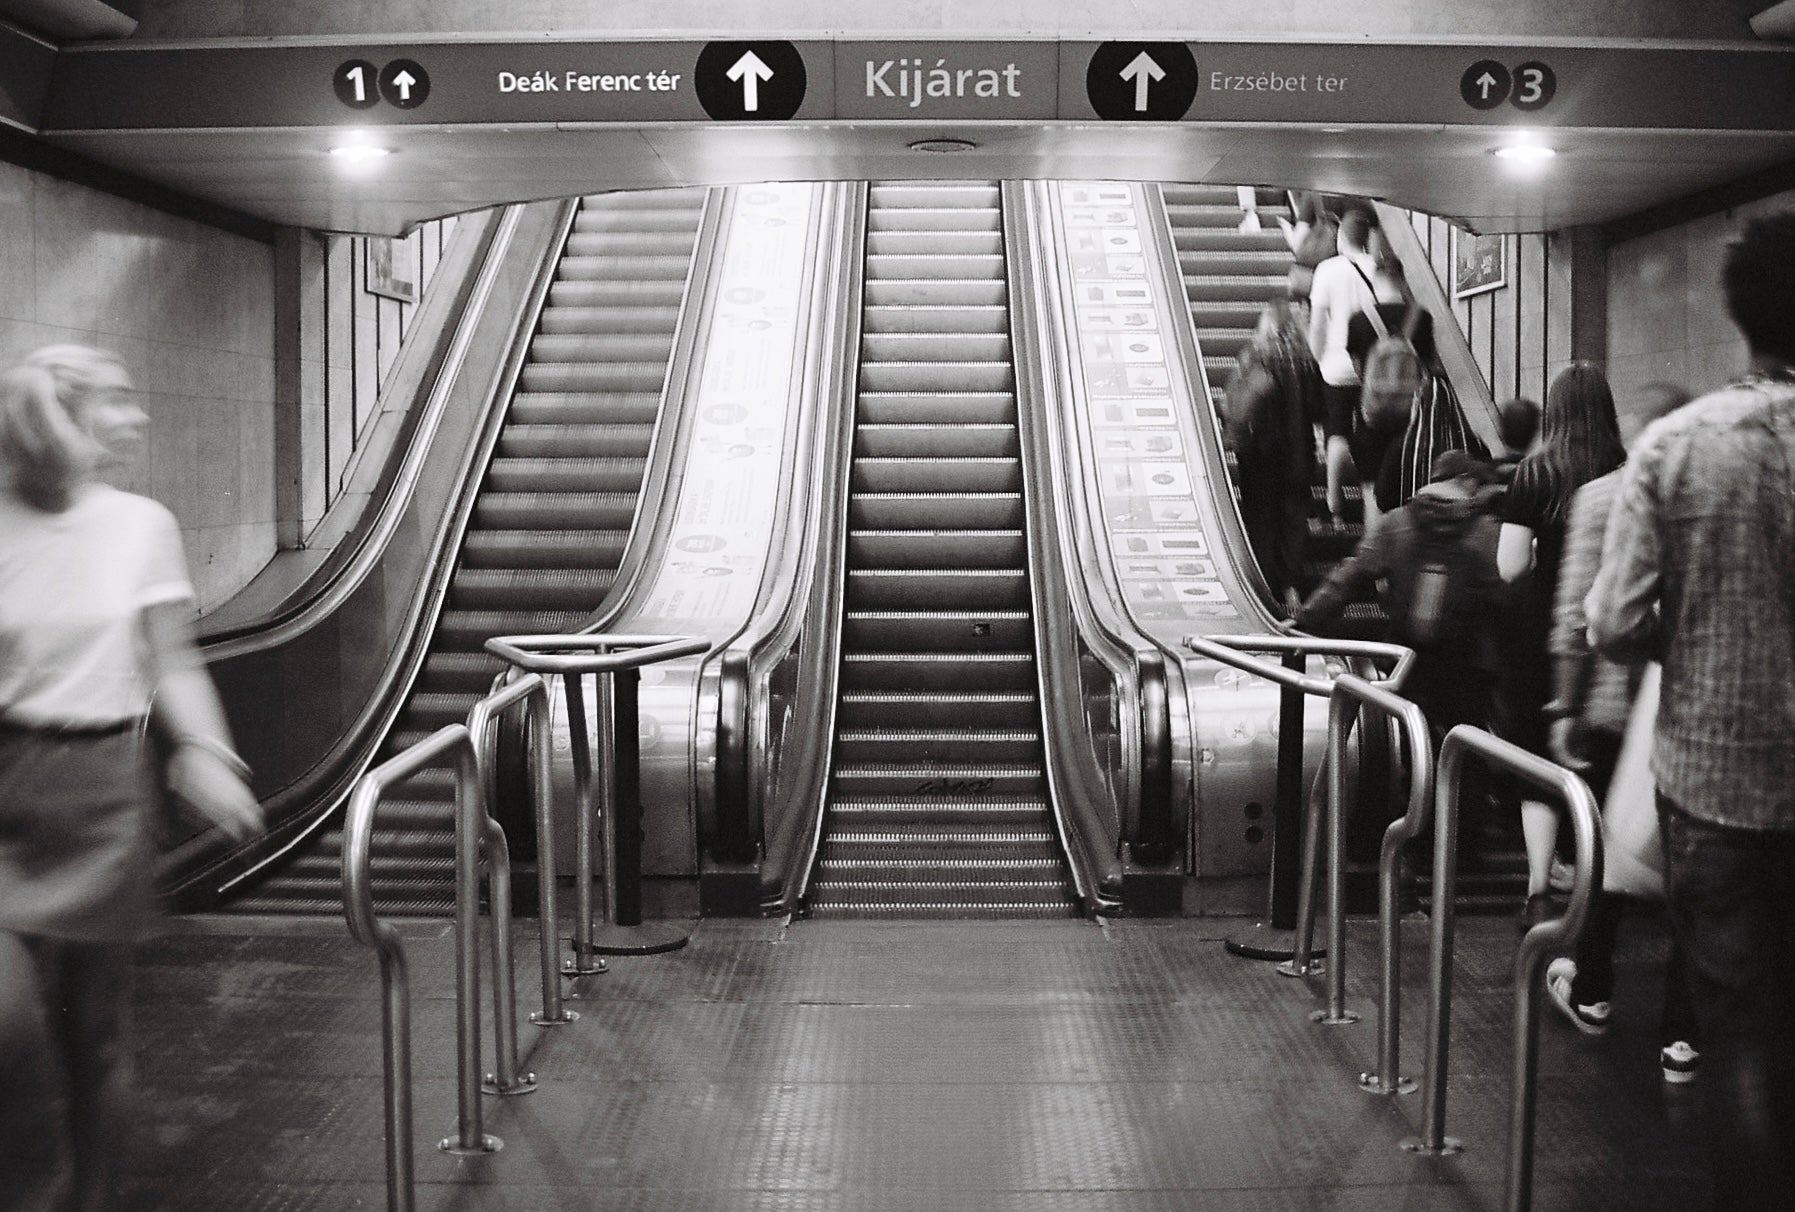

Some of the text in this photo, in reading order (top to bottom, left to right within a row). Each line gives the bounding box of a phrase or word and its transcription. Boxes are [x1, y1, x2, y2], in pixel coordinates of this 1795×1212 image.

[346, 66, 365, 101] 1
[498, 70, 681, 93] Deák Ferenc tér
[866, 58, 1021, 108] Kijárat
[1210, 71, 1308, 92] Erzsébet
[1519, 69, 1543, 103] 3
